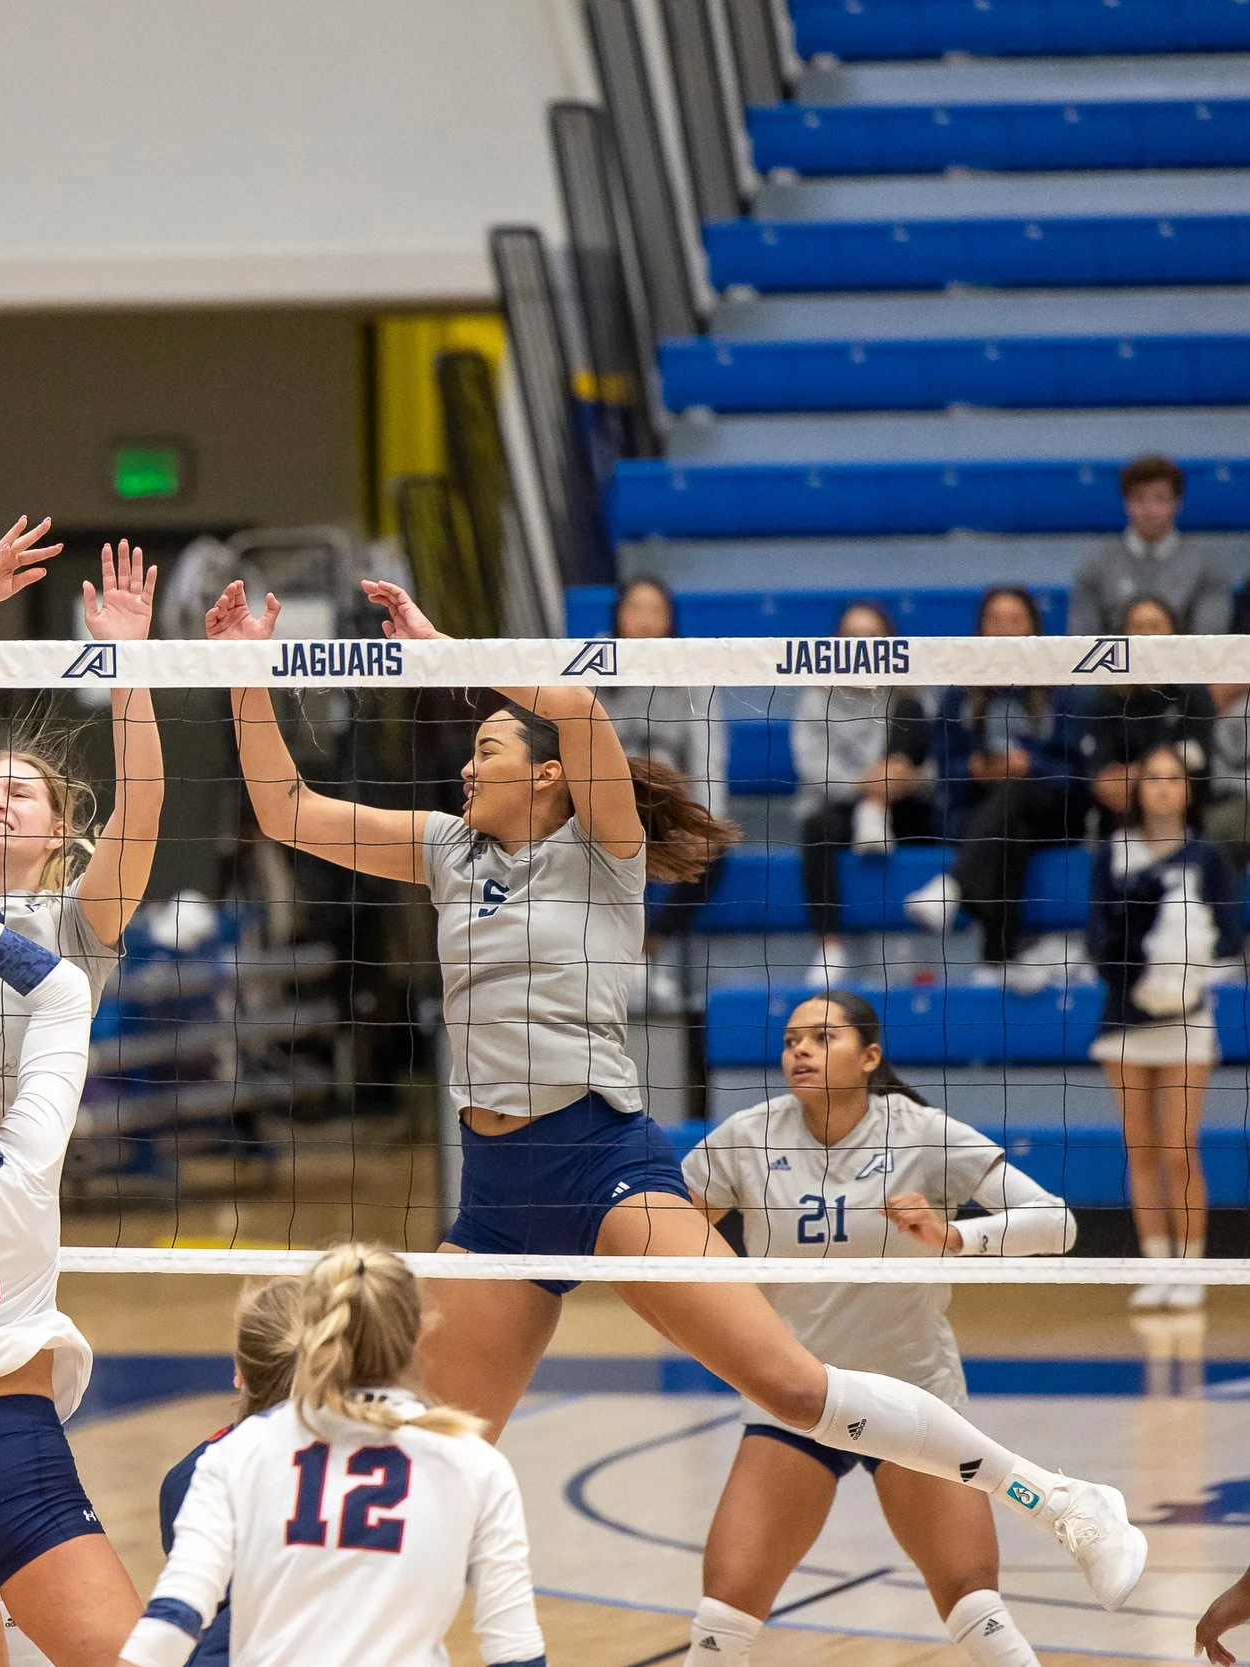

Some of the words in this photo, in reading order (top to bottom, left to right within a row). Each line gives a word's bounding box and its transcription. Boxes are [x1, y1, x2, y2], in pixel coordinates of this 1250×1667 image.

[271, 642, 403, 677] JAGUARS
[776, 639, 910, 675] JAGUARS
[797, 1194, 848, 1244] 21
[284, 1440, 412, 1554] 12
